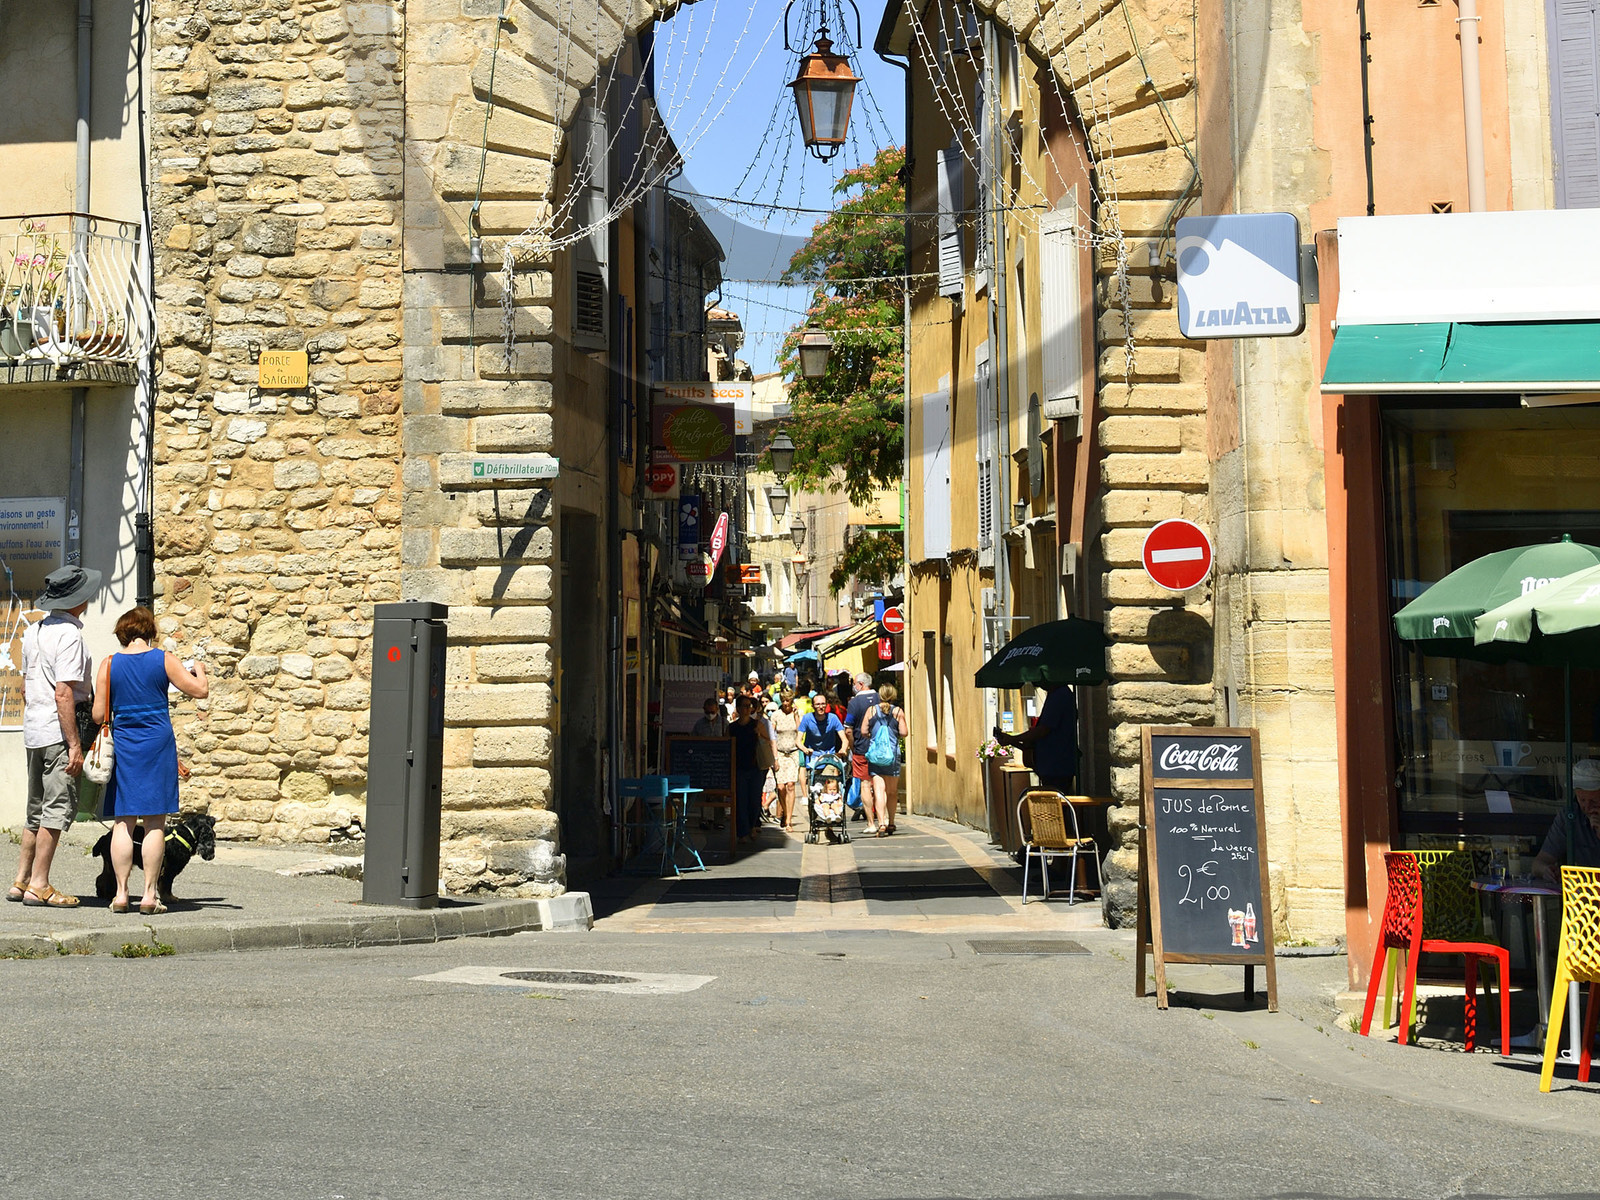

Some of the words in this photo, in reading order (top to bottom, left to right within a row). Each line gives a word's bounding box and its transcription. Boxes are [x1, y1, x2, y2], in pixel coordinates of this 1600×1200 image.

[1195, 302, 1292, 328] LAVAZZA
[664, 386, 705, 398] fruits
[711, 388, 744, 398] secs
[487, 464, 543, 474] Défibrillateur
[37, 509, 55, 519] geste
[711, 516, 726, 561] TABA
[10, 551, 52, 560] renouvelable
[1160, 743, 1242, 772] Coca-Cola
[1162, 798, 1193, 813] JUS
[1198, 799, 1213, 813] de
